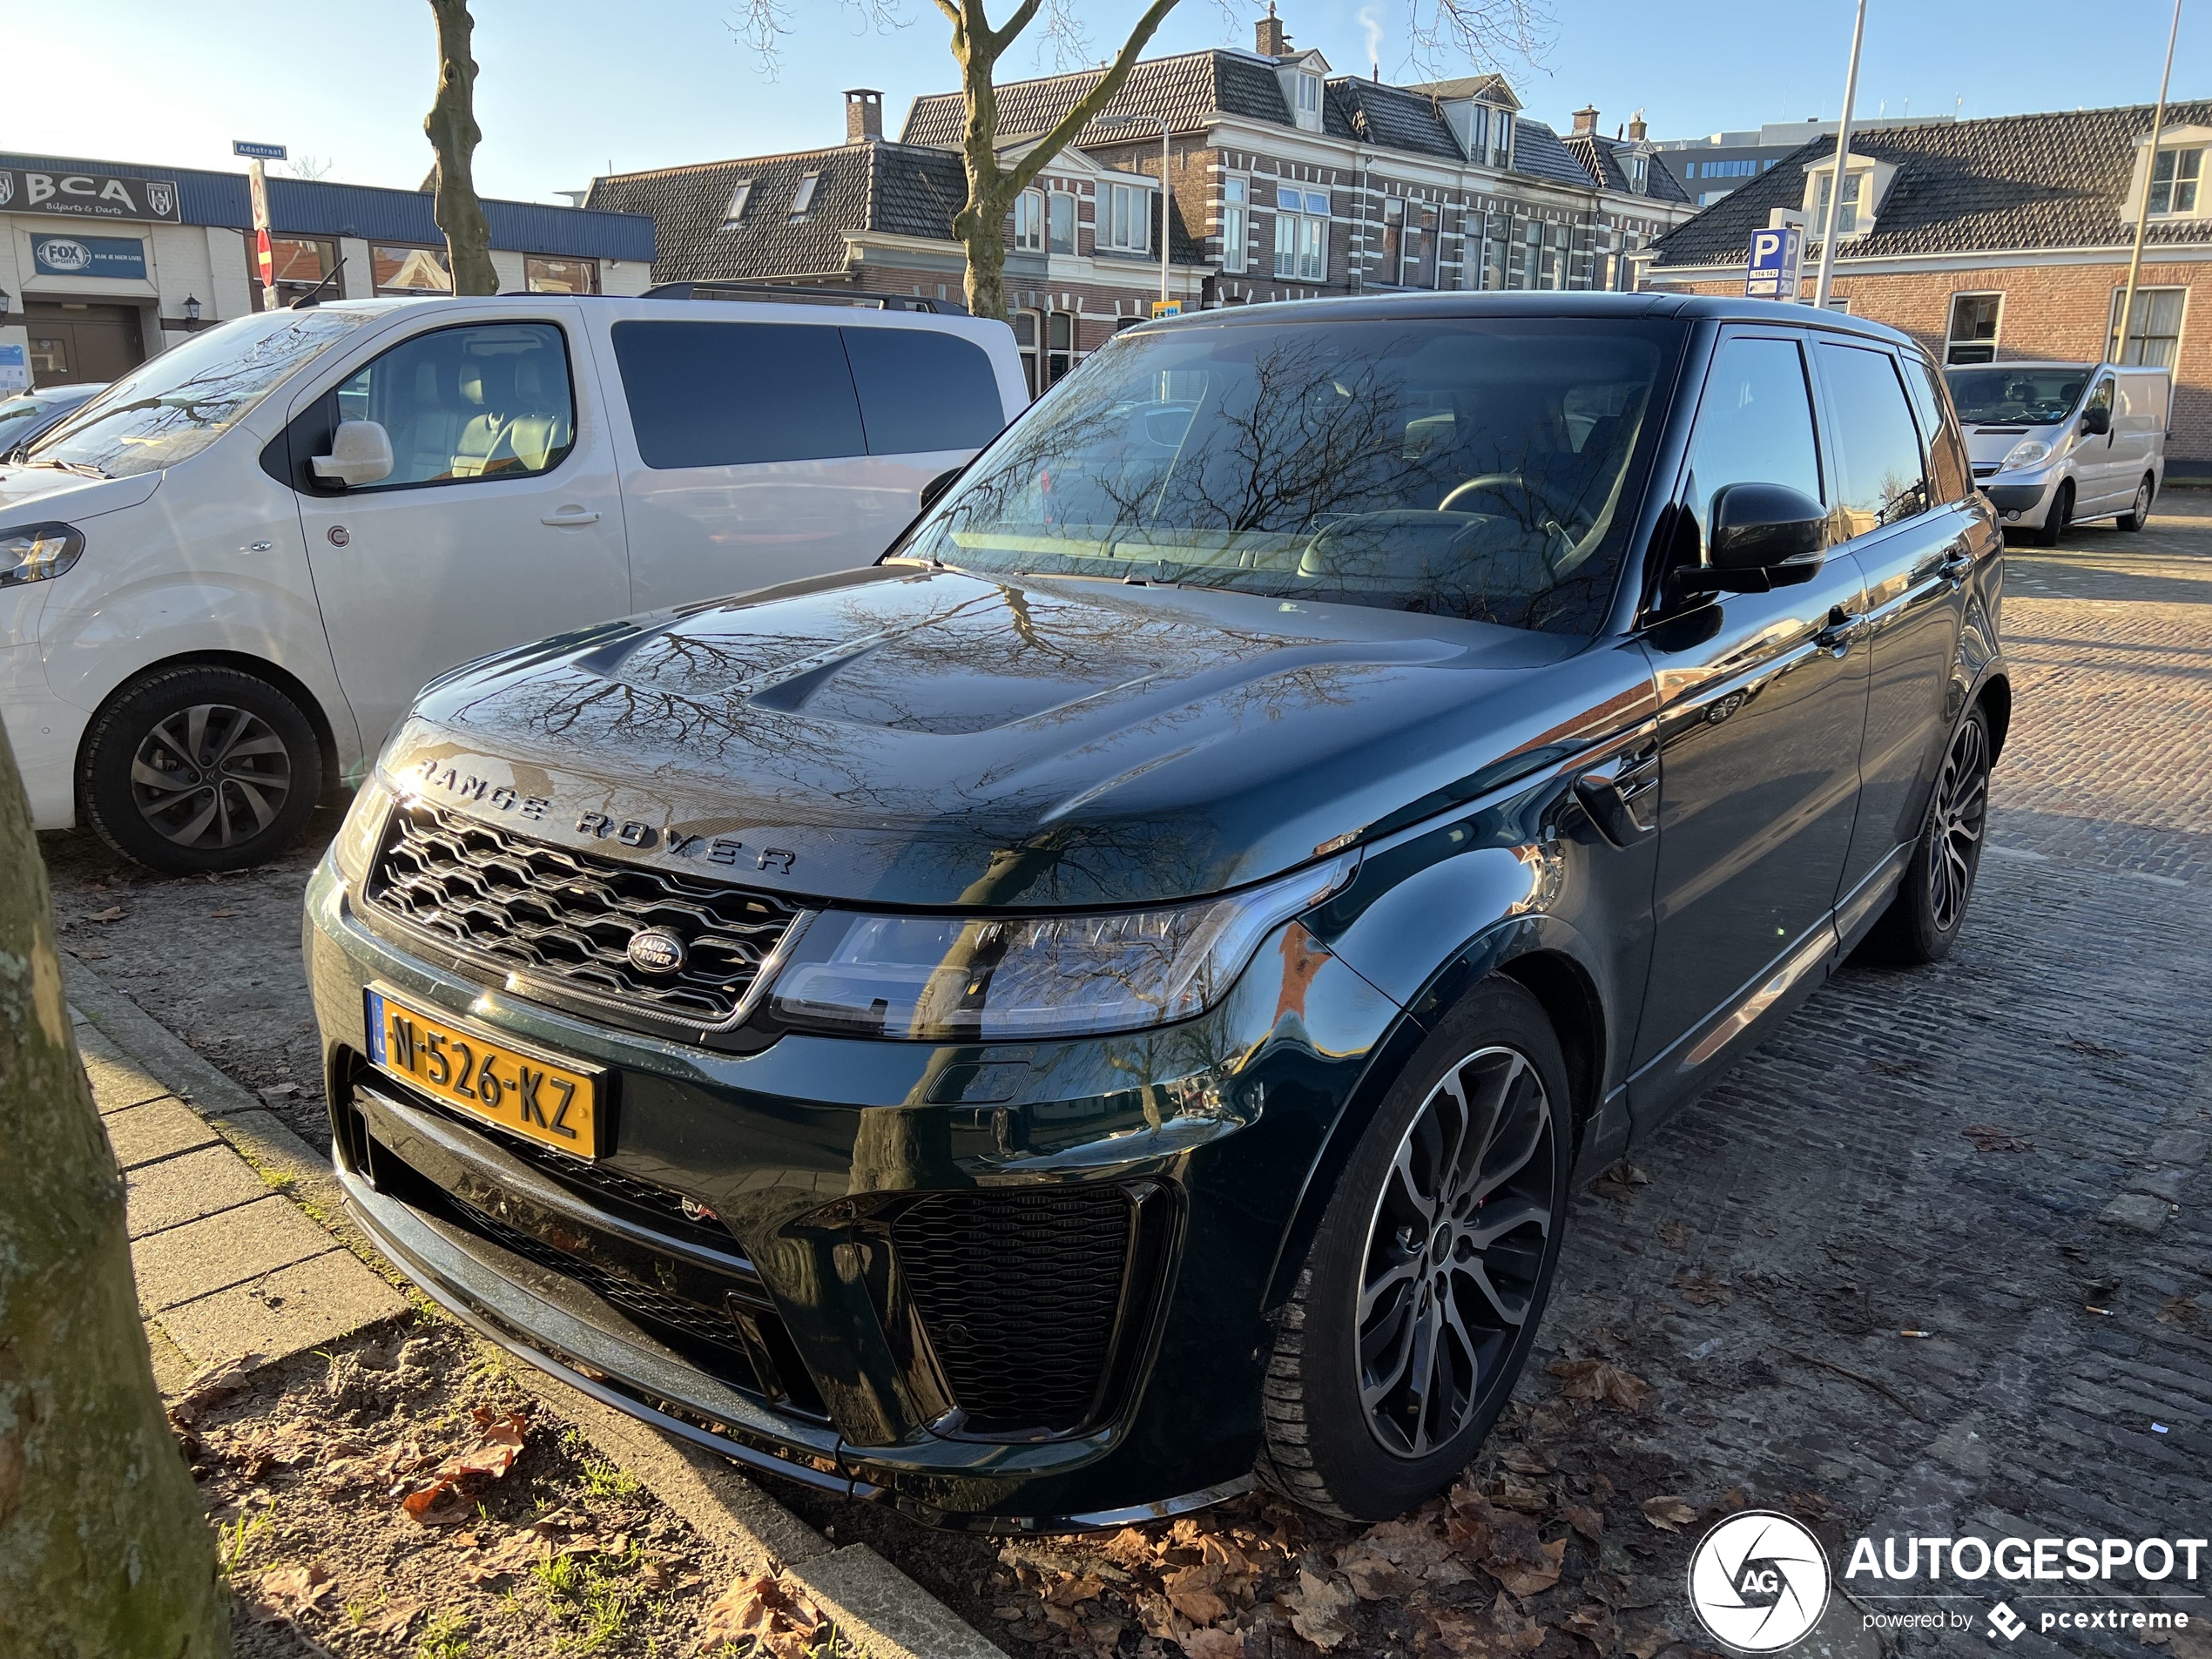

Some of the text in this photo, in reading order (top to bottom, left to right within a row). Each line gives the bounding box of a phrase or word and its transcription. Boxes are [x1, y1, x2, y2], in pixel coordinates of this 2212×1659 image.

[239, 145, 282, 156] Adastraat
[25, 173, 138, 212] BCA
[45, 202, 123, 215] Biljarts & Darts
[48, 245, 79, 259] FOX
[1753, 234, 1780, 267] P
[1784, 234, 1797, 266] P
[415, 757, 798, 874] RANGE ROVER
[639, 948, 673, 966] ROVER
[640, 938, 667, 953] LAND
[391, 1012, 577, 1140] N-526-KZ
